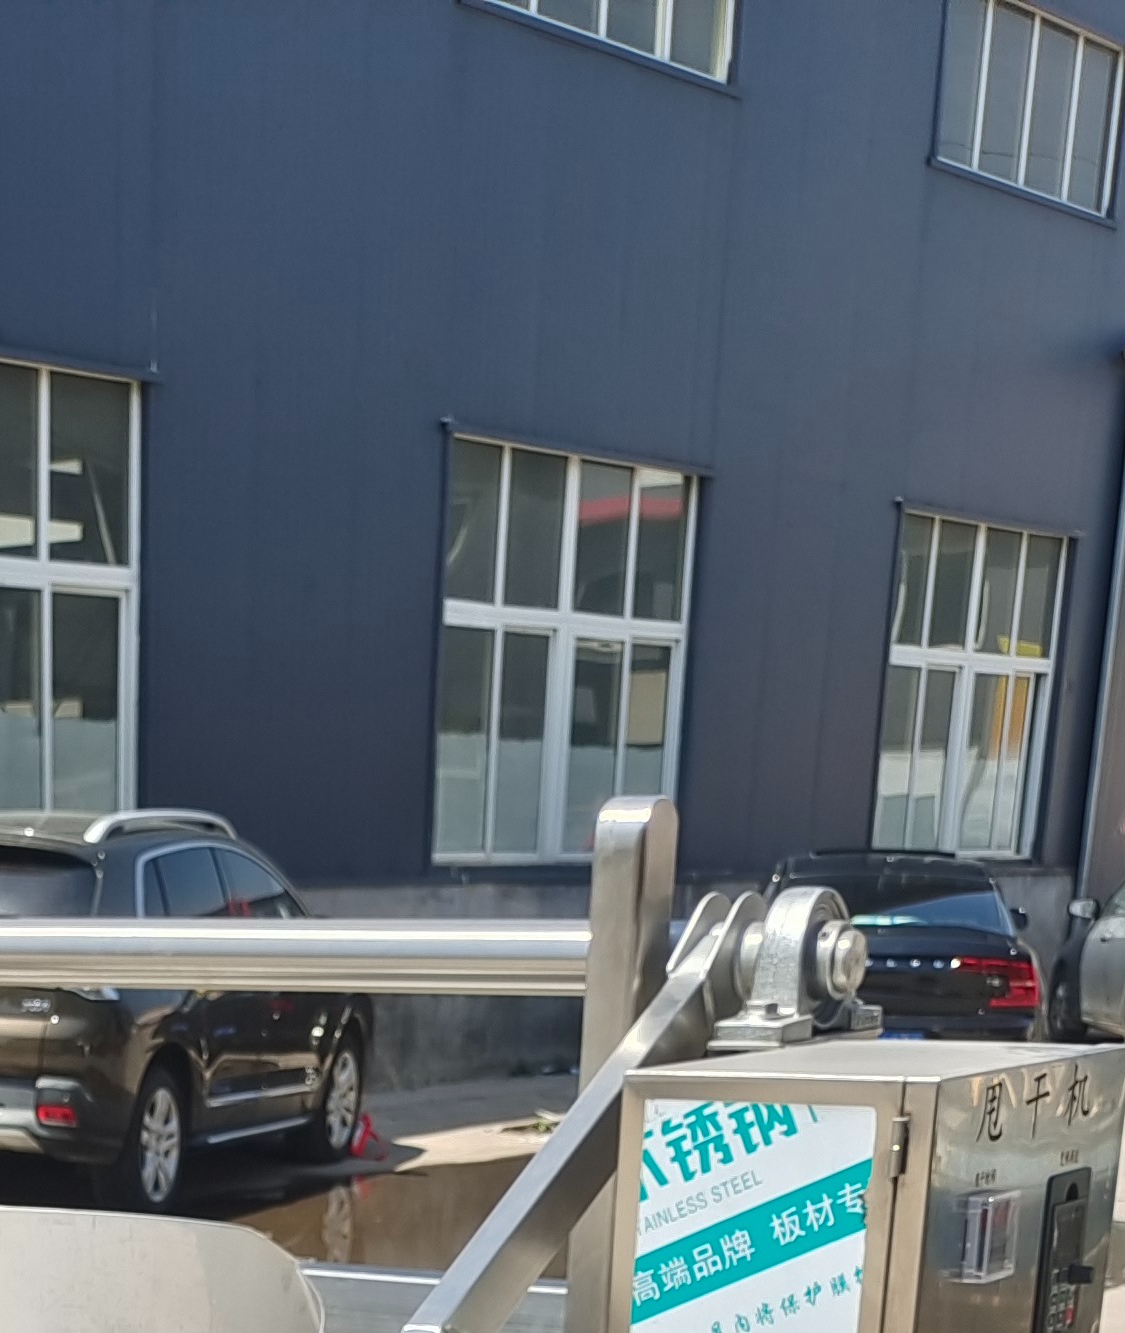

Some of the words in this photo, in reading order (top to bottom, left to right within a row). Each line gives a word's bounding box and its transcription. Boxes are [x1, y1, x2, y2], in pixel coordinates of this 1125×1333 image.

[976, 1063, 1089, 1142] 甩干机
[710, 1170, 763, 1205] STEEL
[632, 1229, 756, 1307] 高端品牌
